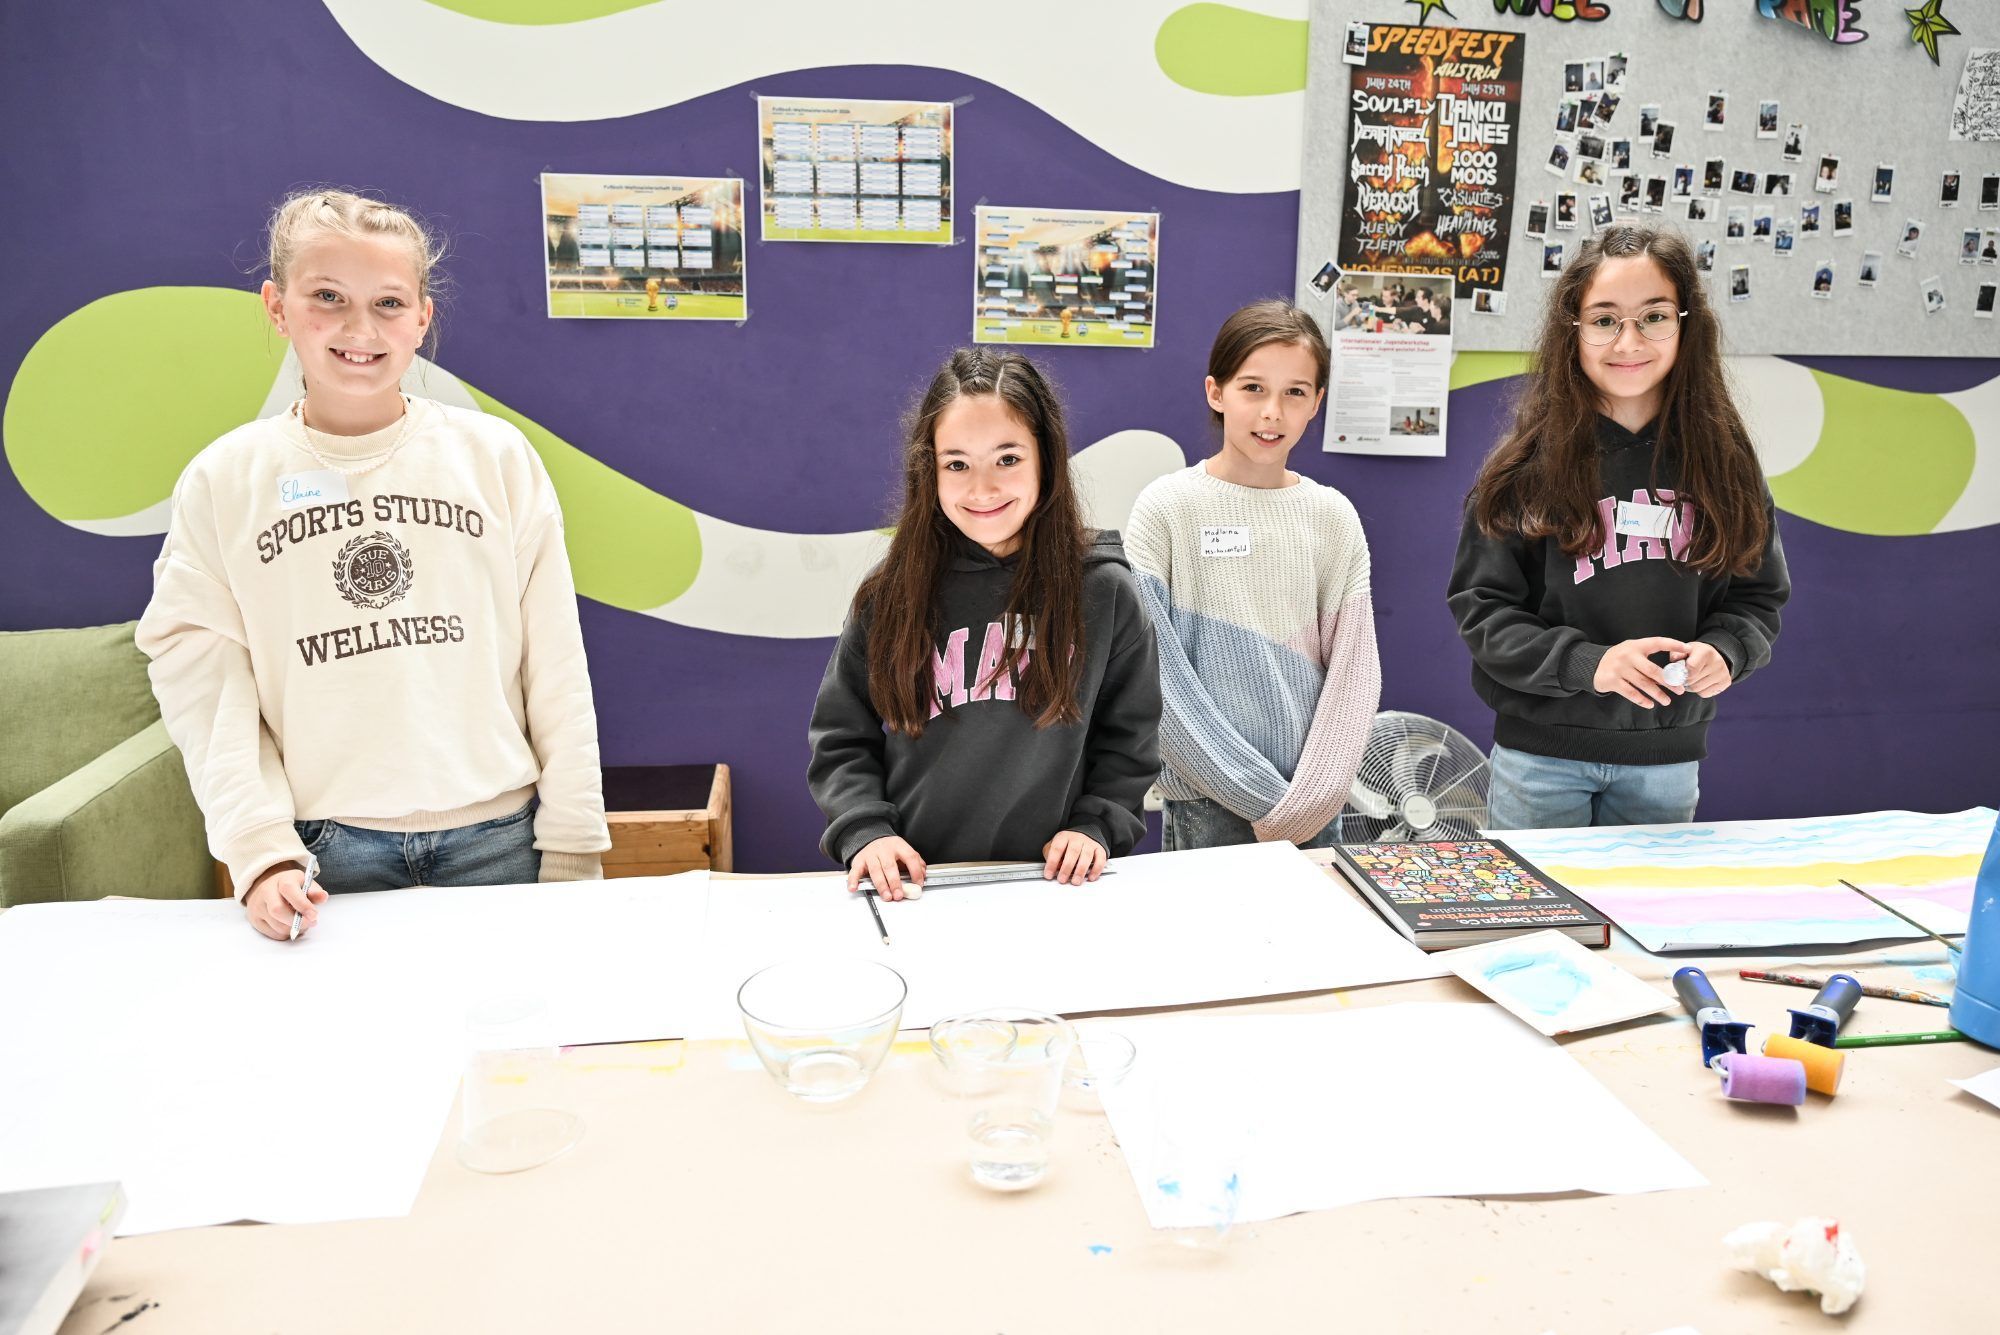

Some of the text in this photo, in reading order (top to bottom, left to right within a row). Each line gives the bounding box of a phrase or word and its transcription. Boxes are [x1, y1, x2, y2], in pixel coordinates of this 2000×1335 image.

[1366, 26, 1515, 67] SPEEDFEST
[1433, 62, 1502, 81] AUSTRIA
[1387, 78, 1411, 91] 24TH
[1482, 84, 1506, 95] 25TH
[1435, 93, 1507, 126] DANKO
[1446, 120, 1511, 148] JONES
[1452, 150, 1498, 168] 1000
[1450, 167, 1498, 186] MODS
[1354, 181, 1421, 221] NERVOSA
[1458, 266, 1500, 284] (AT)
[256, 495, 484, 564] SPORTS STUDIO
[356, 549, 390, 566] RUE
[364, 560, 385, 579] 10
[354, 569, 397, 591] PARIS
[296, 615, 465, 667] WELLNESS
[1419, 909, 1582, 920] Pretty Much Everything
[1427, 906, 1482, 914] Draplin
[1535, 914, 1588, 923] Draplin
[1482, 917, 1534, 925] Design
